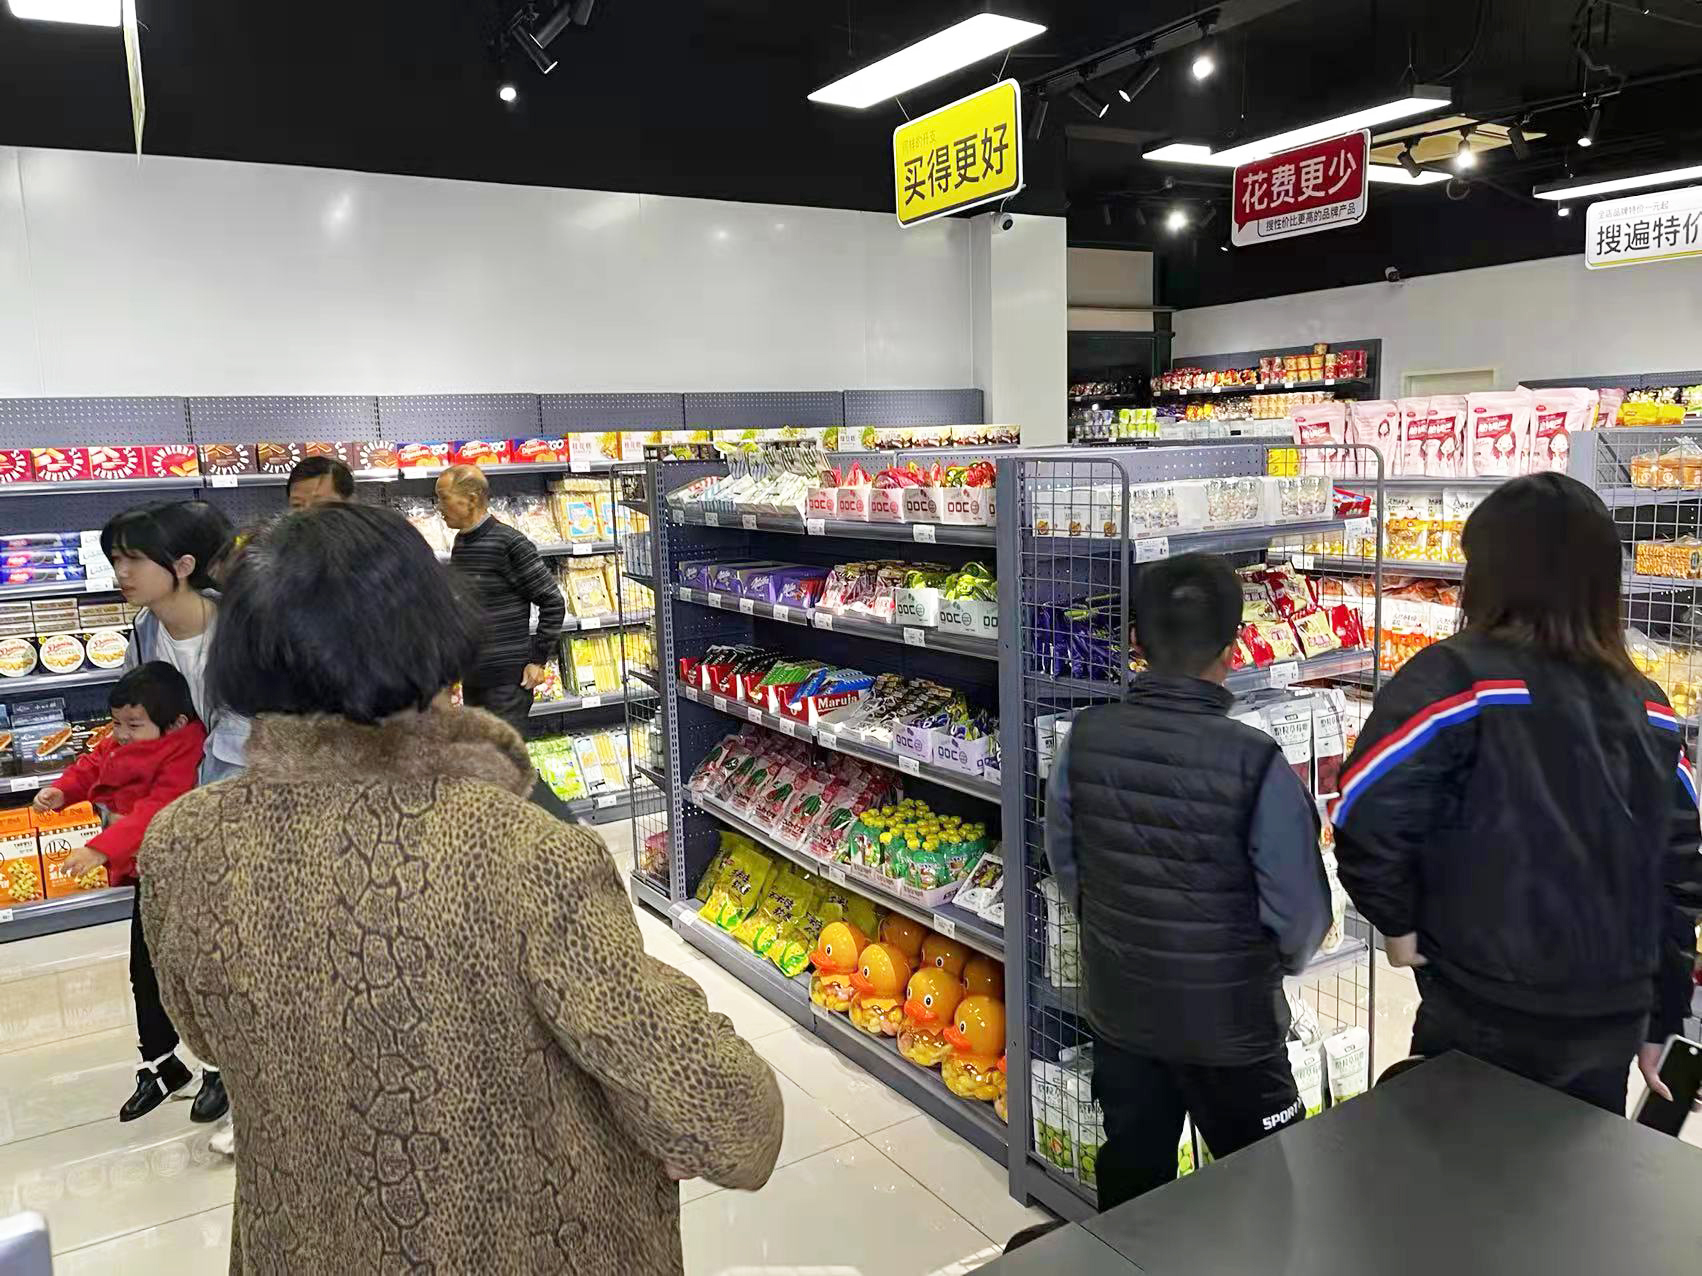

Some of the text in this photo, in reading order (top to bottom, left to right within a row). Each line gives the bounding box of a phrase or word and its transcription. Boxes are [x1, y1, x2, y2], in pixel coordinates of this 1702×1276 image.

[904, 122, 1009, 206] 买得更好
[1242, 148, 1357, 214] 花费更少
[1596, 211, 1702, 256] 搜遍特价
[818, 693, 858, 710] Maruja
